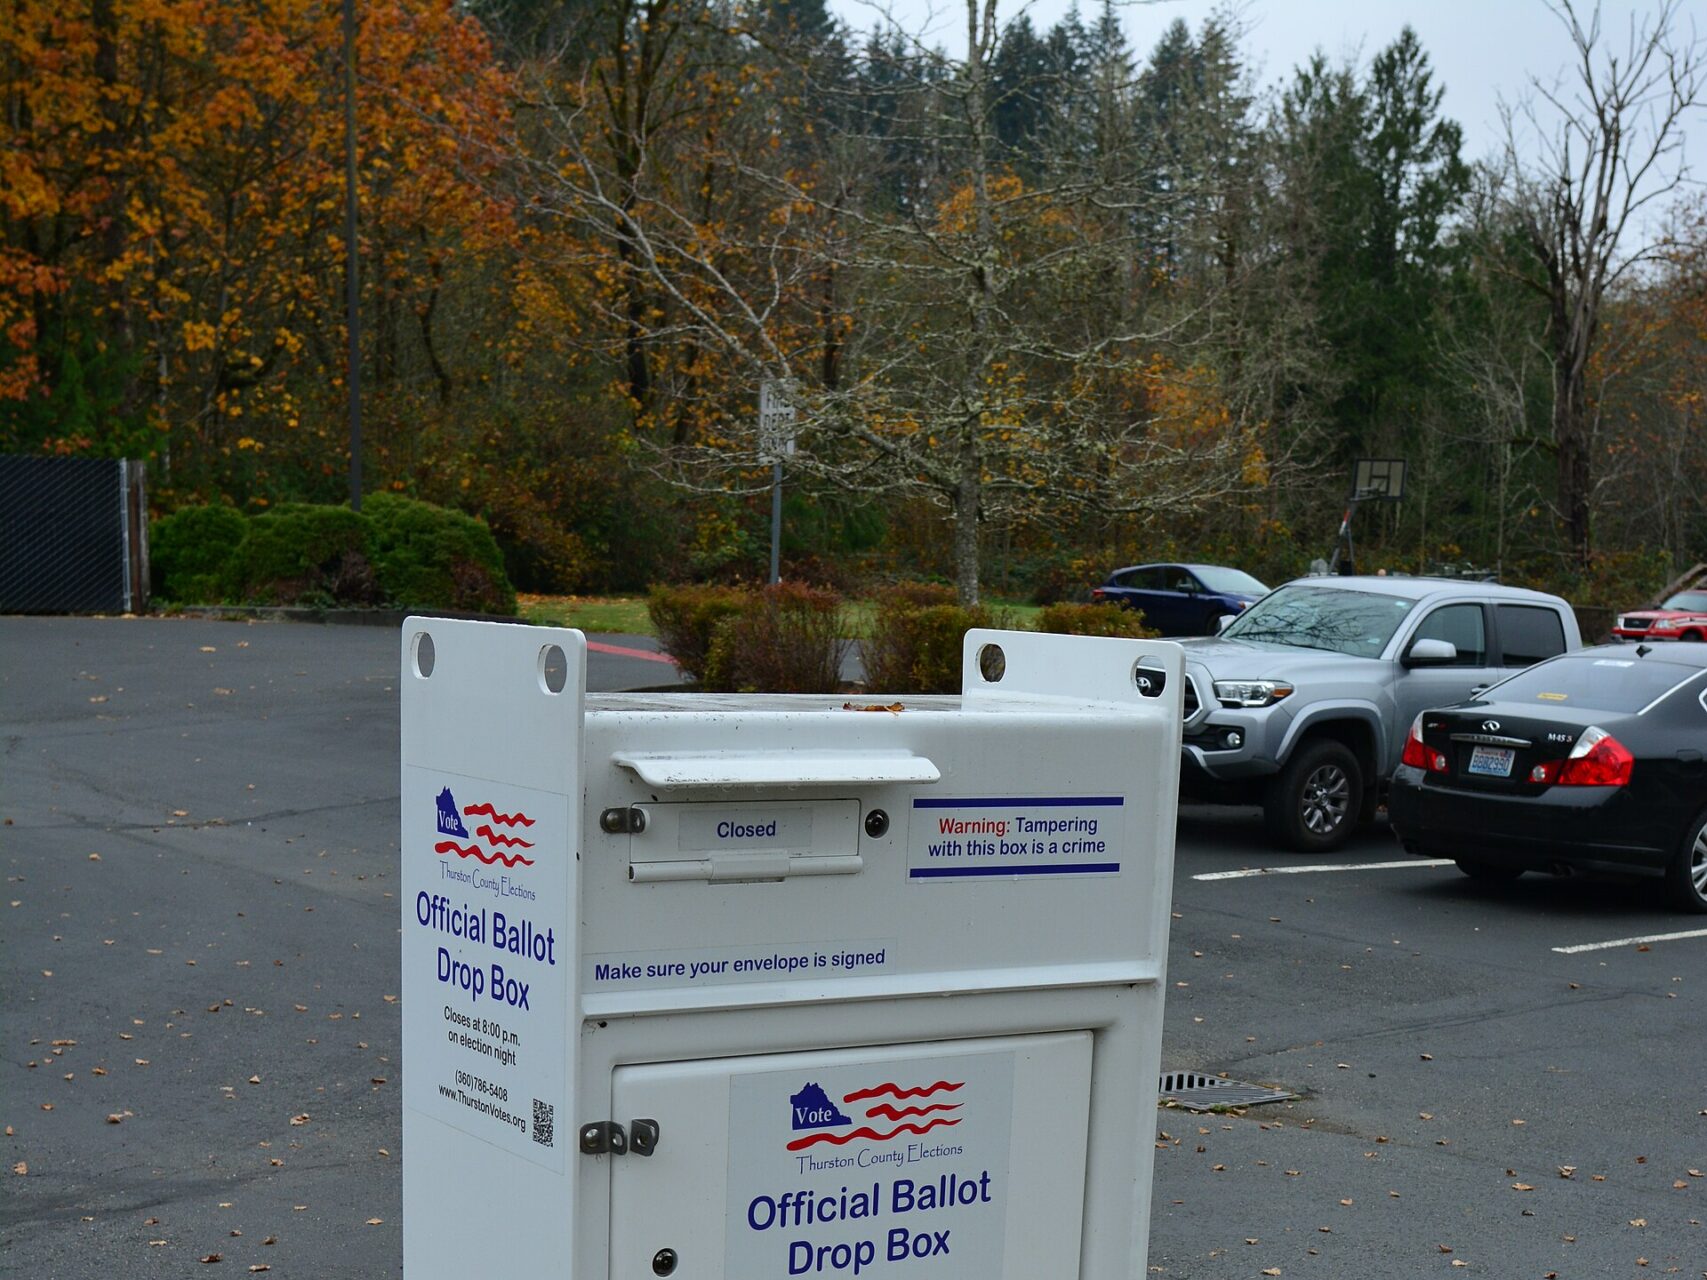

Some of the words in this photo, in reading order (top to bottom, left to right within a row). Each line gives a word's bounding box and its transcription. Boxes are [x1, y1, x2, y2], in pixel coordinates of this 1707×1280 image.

[439, 809, 458, 831] Vote
[717, 821, 776, 838] Closed
[939, 818, 1010, 837] Warning:
[1016, 817, 1097, 836] Tampering
[928, 841, 961, 856] with
[967, 839, 995, 855] this
[1000, 839, 1027, 855] box
[1032, 839, 1043, 854] is
[1049, 843, 1057, 854] a
[1062, 839, 1105, 853] crime
[440, 861, 471, 884] Thurston
[472, 869, 499, 898] County
[501, 876, 536, 901] Elections
[417, 891, 486, 945] Official
[493, 912, 555, 965] Ballot
[438, 947, 484, 1001] Drop
[491, 965, 529, 1011] Box
[595, 964, 641, 980] Make
[646, 961, 684, 978] sure
[690, 958, 728, 978] your
[734, 953, 808, 972] envelope
[814, 952, 826, 968] is
[831, 949, 885, 969] signed
[444, 1006, 470, 1029] Closes
[472, 1016, 480, 1031] at
[482, 1020, 500, 1040] 8:00
[502, 1028, 520, 1047] p.m.
[449, 1031, 458, 1043] on
[460, 1032, 492, 1057] election
[494, 1043, 516, 1067] night
[455, 1069, 508, 1101] (360)786-5408
[439, 1084, 526, 1133] www.ThurstonVotes.org
[796, 1106, 832, 1125] Vote
[796, 1155, 854, 1175] Thurston
[858, 1148, 904, 1168] County
[908, 1143, 962, 1163] Elections
[748, 1182, 879, 1231] Official
[892, 1170, 991, 1213] Ballot
[789, 1240, 874, 1275] Drop
[887, 1227, 950, 1261] Box
